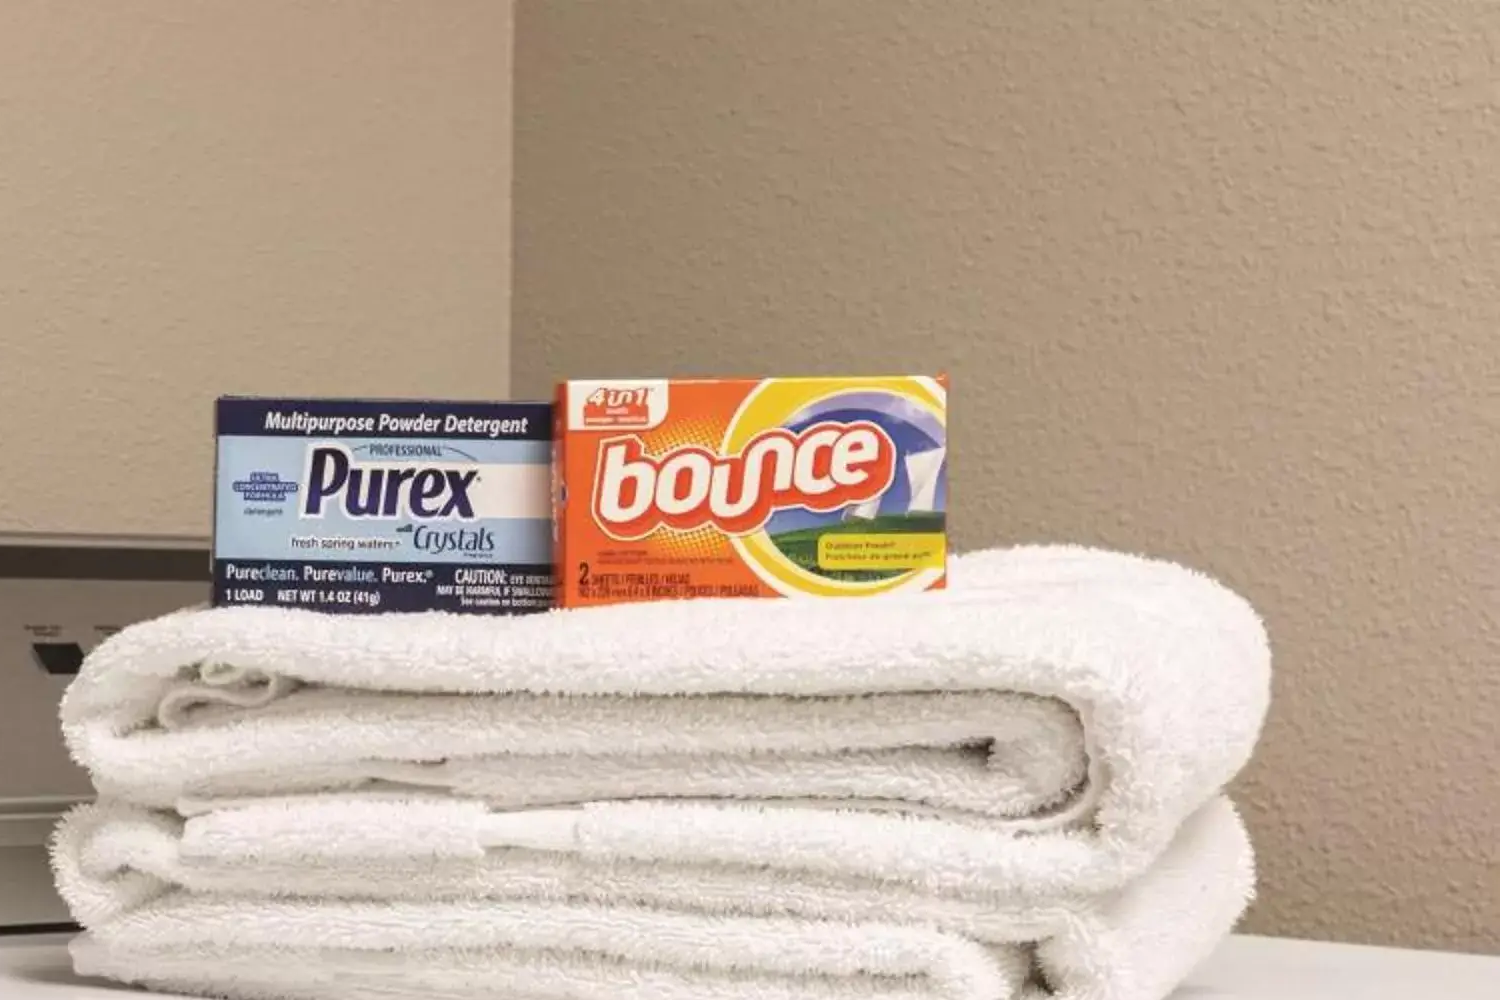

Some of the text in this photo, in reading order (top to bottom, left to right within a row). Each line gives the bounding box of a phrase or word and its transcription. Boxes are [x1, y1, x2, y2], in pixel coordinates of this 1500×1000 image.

[265, 411, 528, 437] Multipurpose Powder Detergent
[369, 443, 443, 457] PROFESSIONAL
[304, 447, 478, 519] Purex
[599, 429, 880, 523] bounce
[291, 537, 318, 549] fresh
[321, 539, 354, 551] spring
[413, 525, 495, 555] Crystals
[226, 563, 299, 581] Pureclean.
[303, 565, 378, 583] Purevalue.
[455, 568, 507, 585] CAUTION:
[579, 562, 590, 585] 2
[225, 589, 264, 601] 1 LOAD
[277, 589, 381, 605] NET WT 1.4 OZ (41g)
